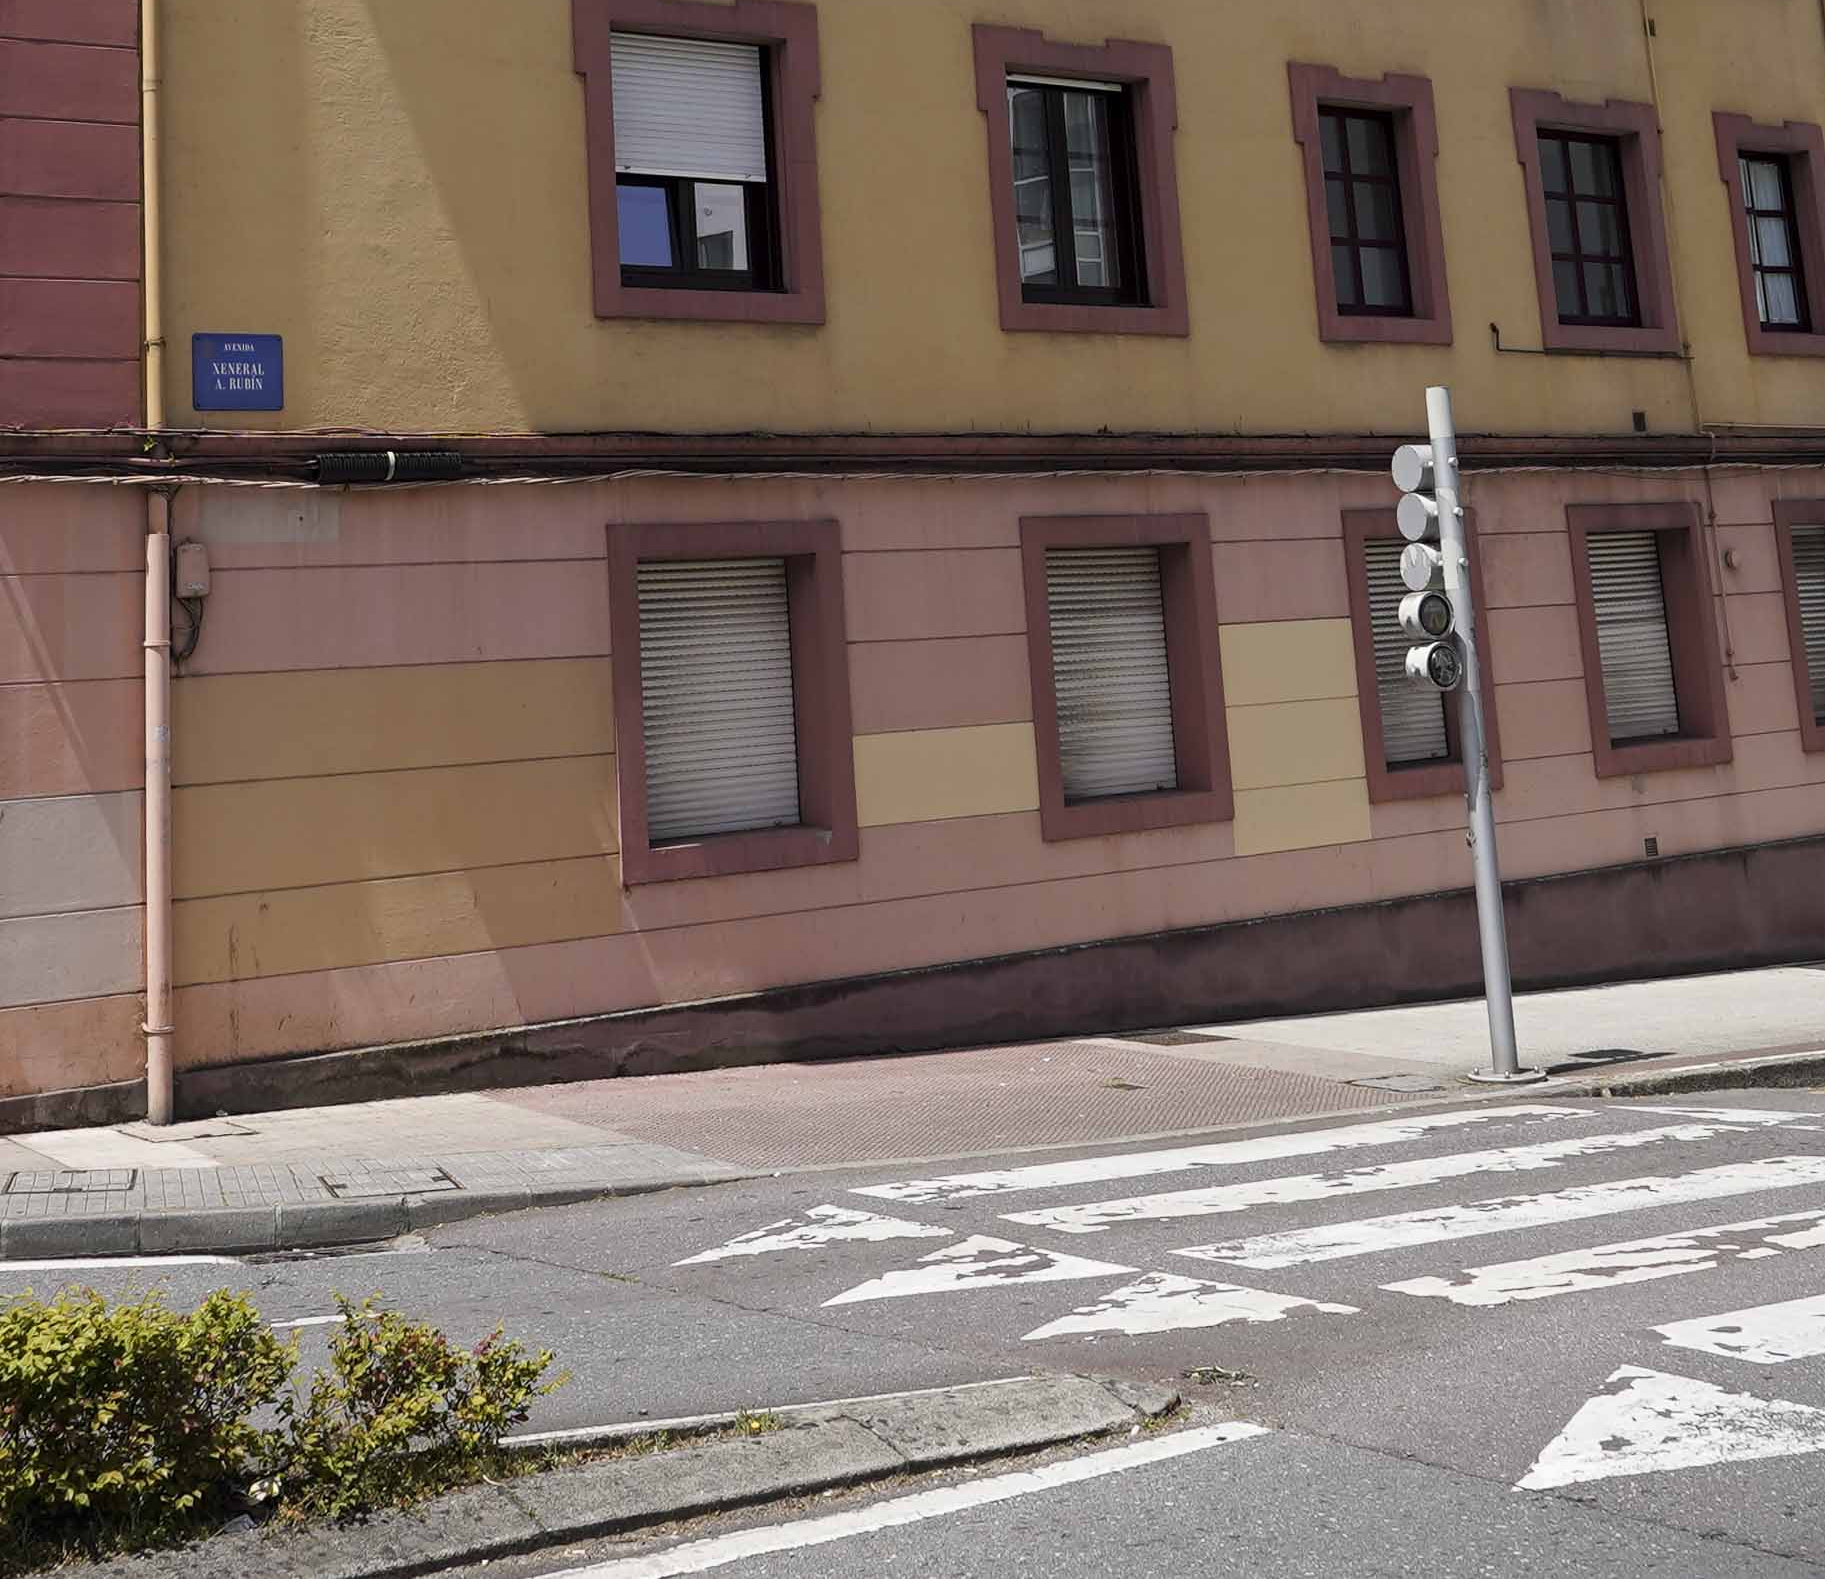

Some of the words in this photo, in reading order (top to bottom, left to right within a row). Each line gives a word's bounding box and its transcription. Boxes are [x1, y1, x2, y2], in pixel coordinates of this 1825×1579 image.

[224, 343, 255, 351] AVENIDA
[213, 362, 264, 375] XENERAL
[216, 378, 226, 390] A.
[229, 375, 263, 390] RUBÍN
